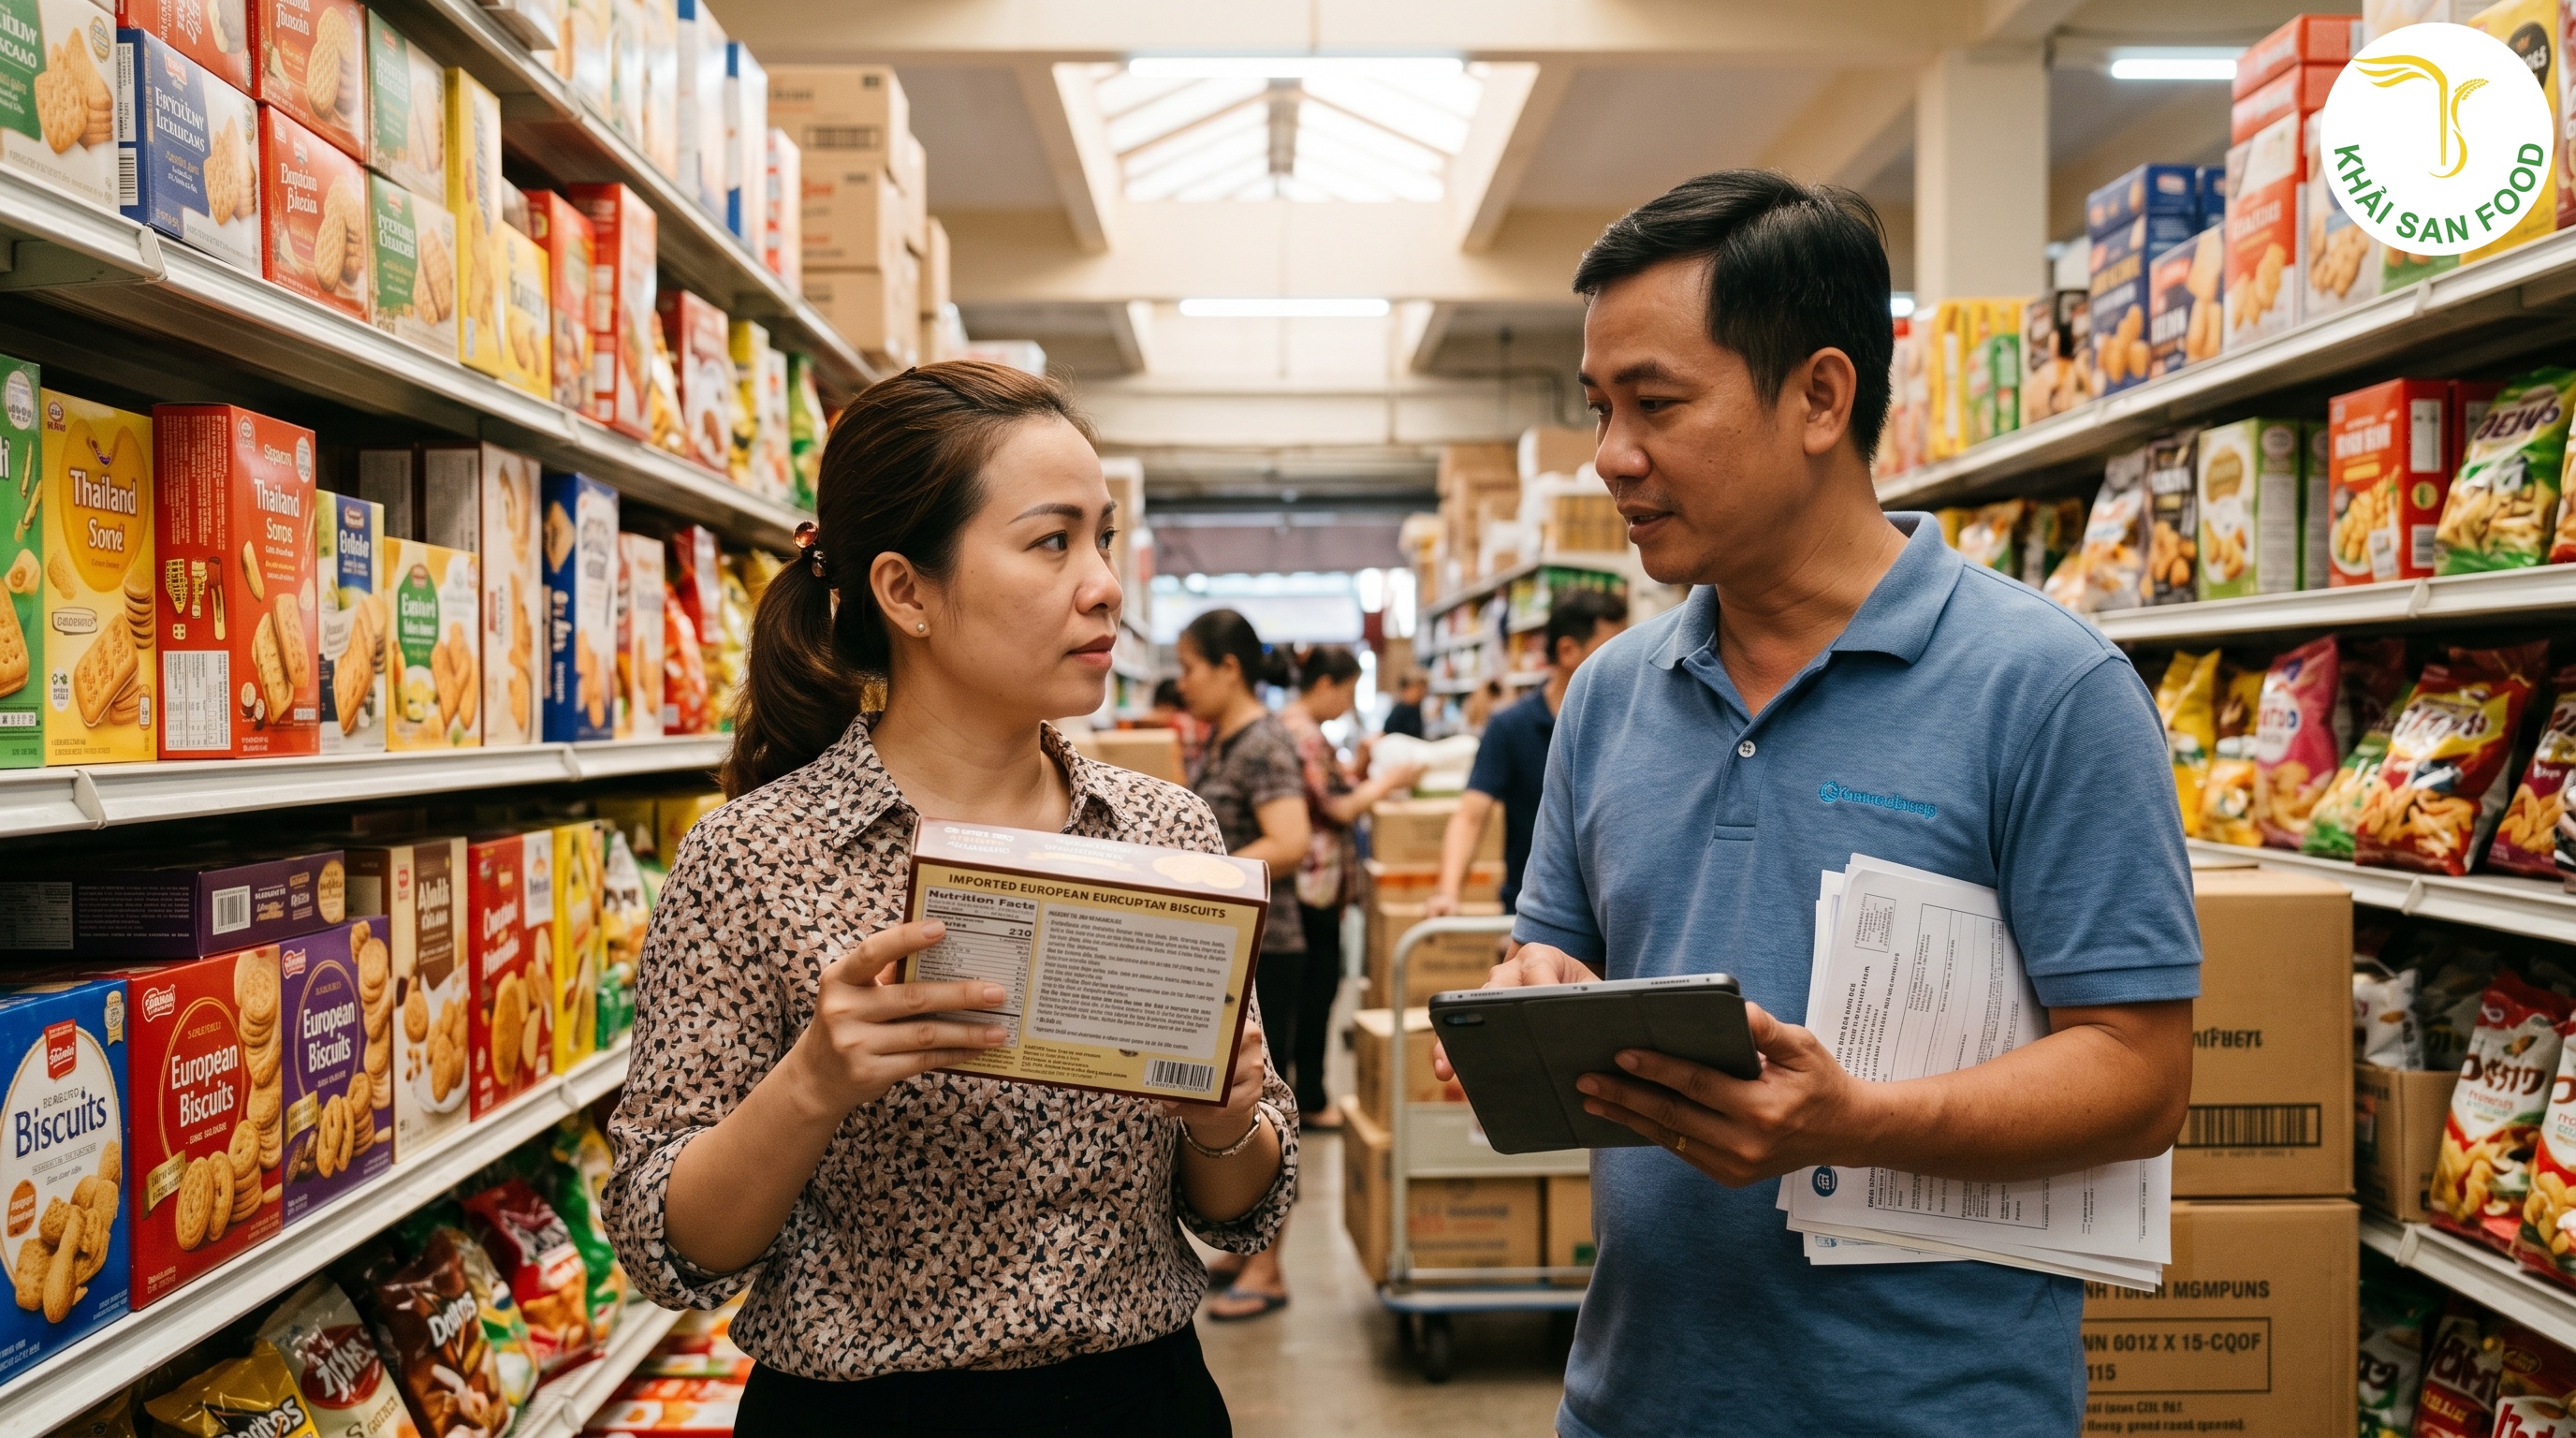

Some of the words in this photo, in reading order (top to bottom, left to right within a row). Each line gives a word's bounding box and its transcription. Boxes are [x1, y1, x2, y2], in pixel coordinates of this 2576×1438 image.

[69, 469, 137, 515] Thailand
[254, 477, 300, 518] Thailand
[928, 889, 994, 905] Nutrition
[948, 873, 1017, 891] IMPORTED
[1020, 883, 1090, 902] EUROPEAN
[1169, 902, 1226, 919] BISCUITS
[303, 1001, 356, 1039] European
[171, 1044, 238, 1091] European
[308, 1032, 351, 1074] Biscuits
[15, 1087, 108, 1159] Biscuits
[180, 1079, 234, 1128] Biscuits
